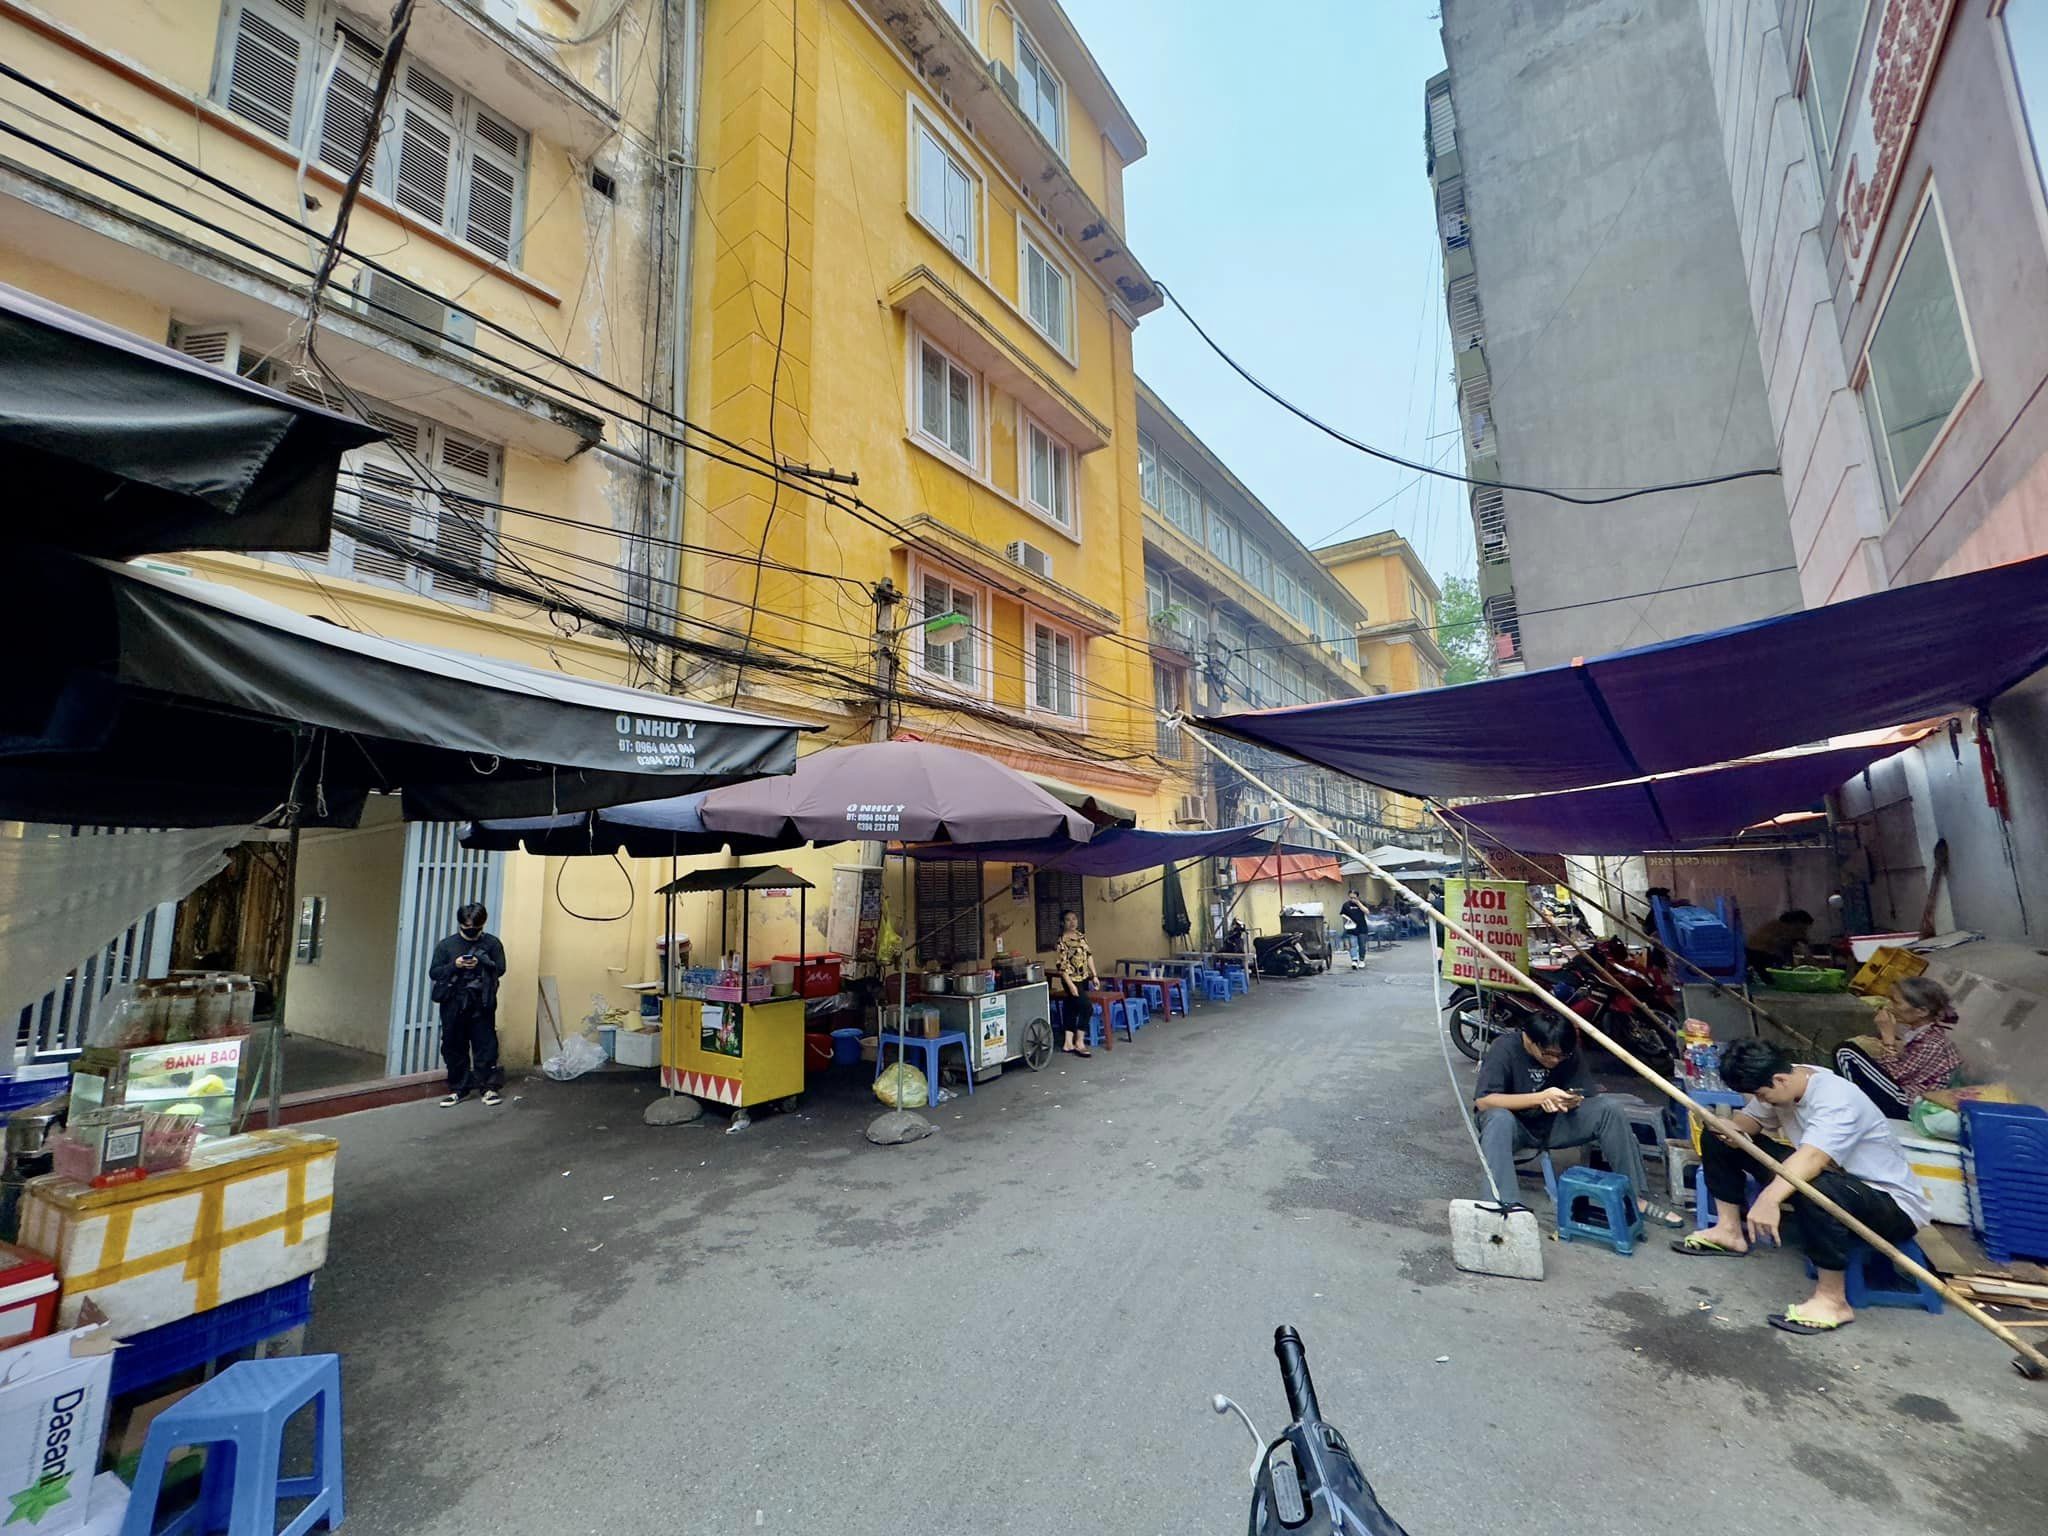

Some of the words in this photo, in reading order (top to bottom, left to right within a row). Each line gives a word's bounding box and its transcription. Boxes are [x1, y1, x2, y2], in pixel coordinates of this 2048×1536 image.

[635, 741, 658, 754] 0964
[659, 742, 677, 754] 043
[663, 755, 680, 767] 233
[1463, 886, 1506, 910] XÔI
[210, 1048, 238, 1064] BAO
[40, 1387, 85, 1487] Dasani
